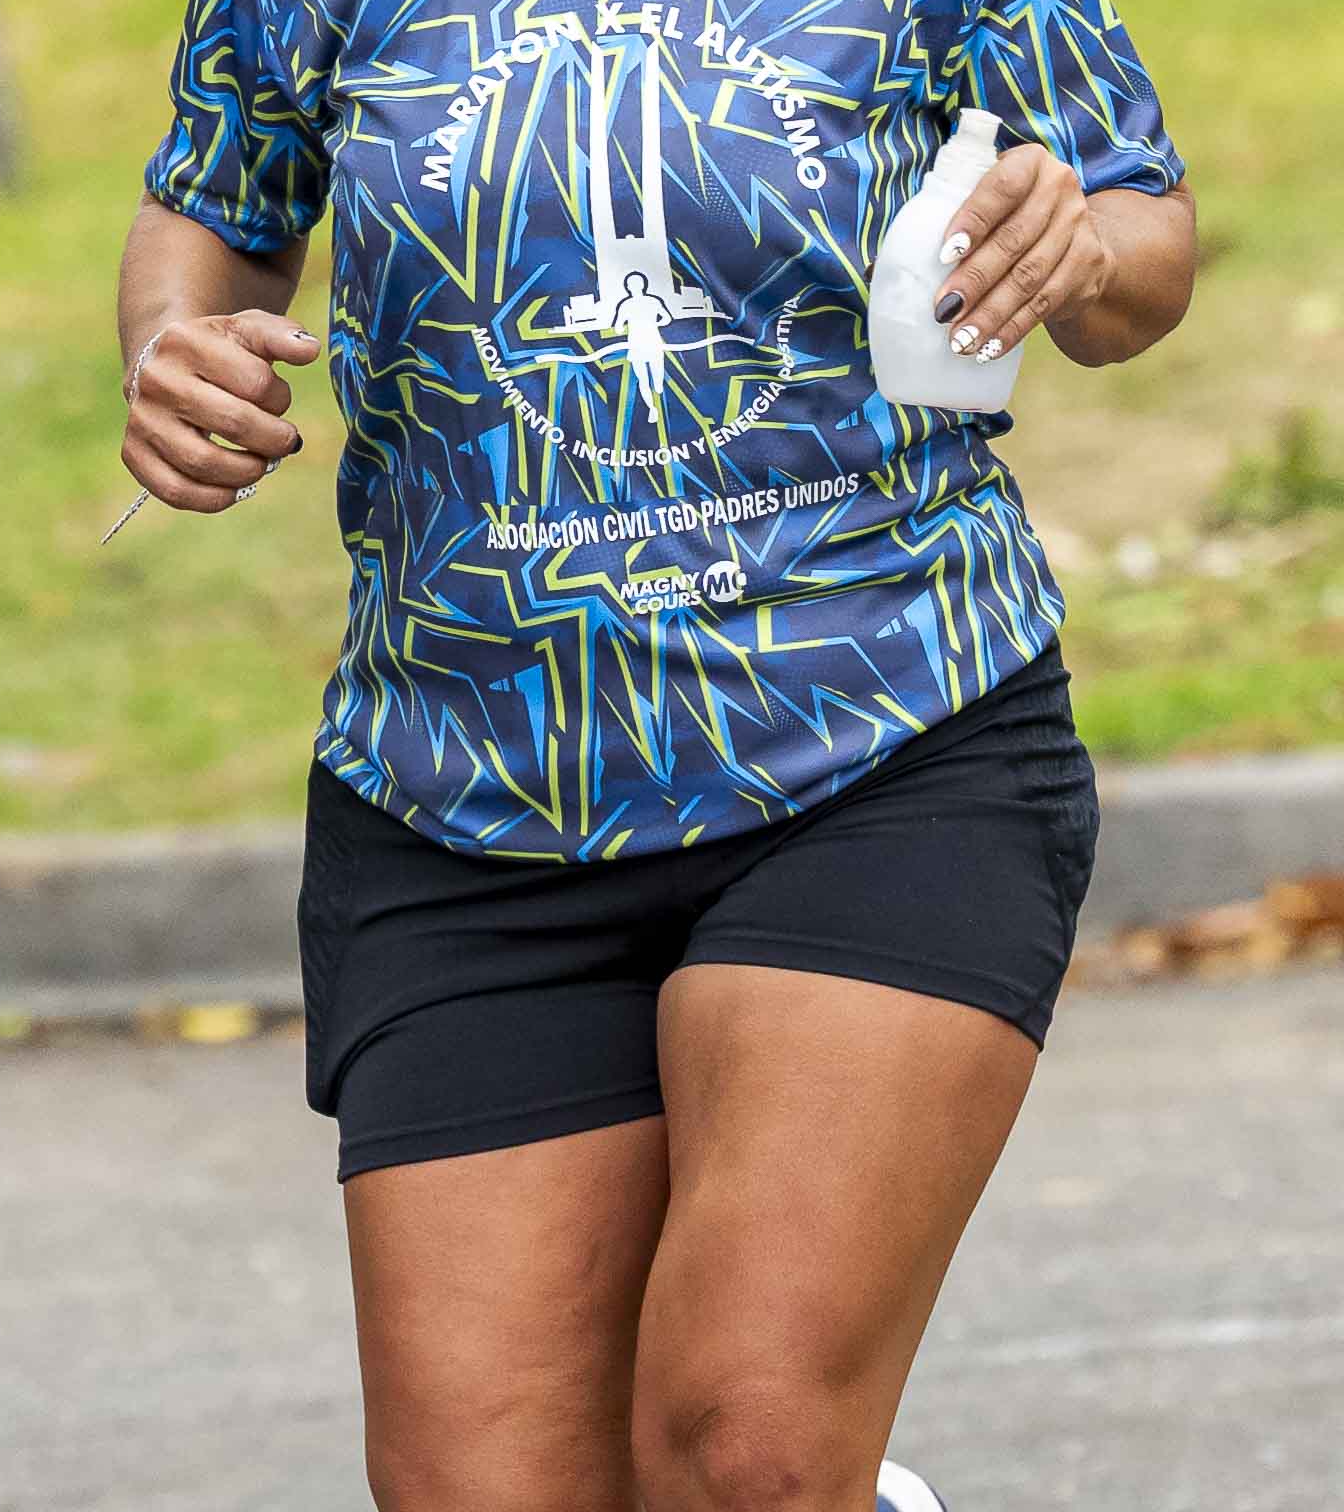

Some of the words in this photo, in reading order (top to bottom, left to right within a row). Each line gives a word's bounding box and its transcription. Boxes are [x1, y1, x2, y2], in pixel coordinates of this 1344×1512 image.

[420, 11, 582, 193] MARATON
[594, 1, 626, 35] X
[640, 2, 684, 40] EL
[693, 21, 827, 190] AUTISMO
[472, 327, 567, 451] MOVIMIENTO,
[691, 436, 707, 455] Y
[710, 381, 787, 448] ENERGÍA
[776, 295, 801, 382] POSITIVA
[486, 510, 599, 552] ASOCIACIÓN
[603, 510, 656, 542] CIVIL
[654, 502, 698, 535] TGD
[700, 490, 779, 526] PADRES
[784, 473, 860, 510] UNIDOS
[620, 571, 700, 600] MAGNY
[634, 590, 703, 615] COURS
